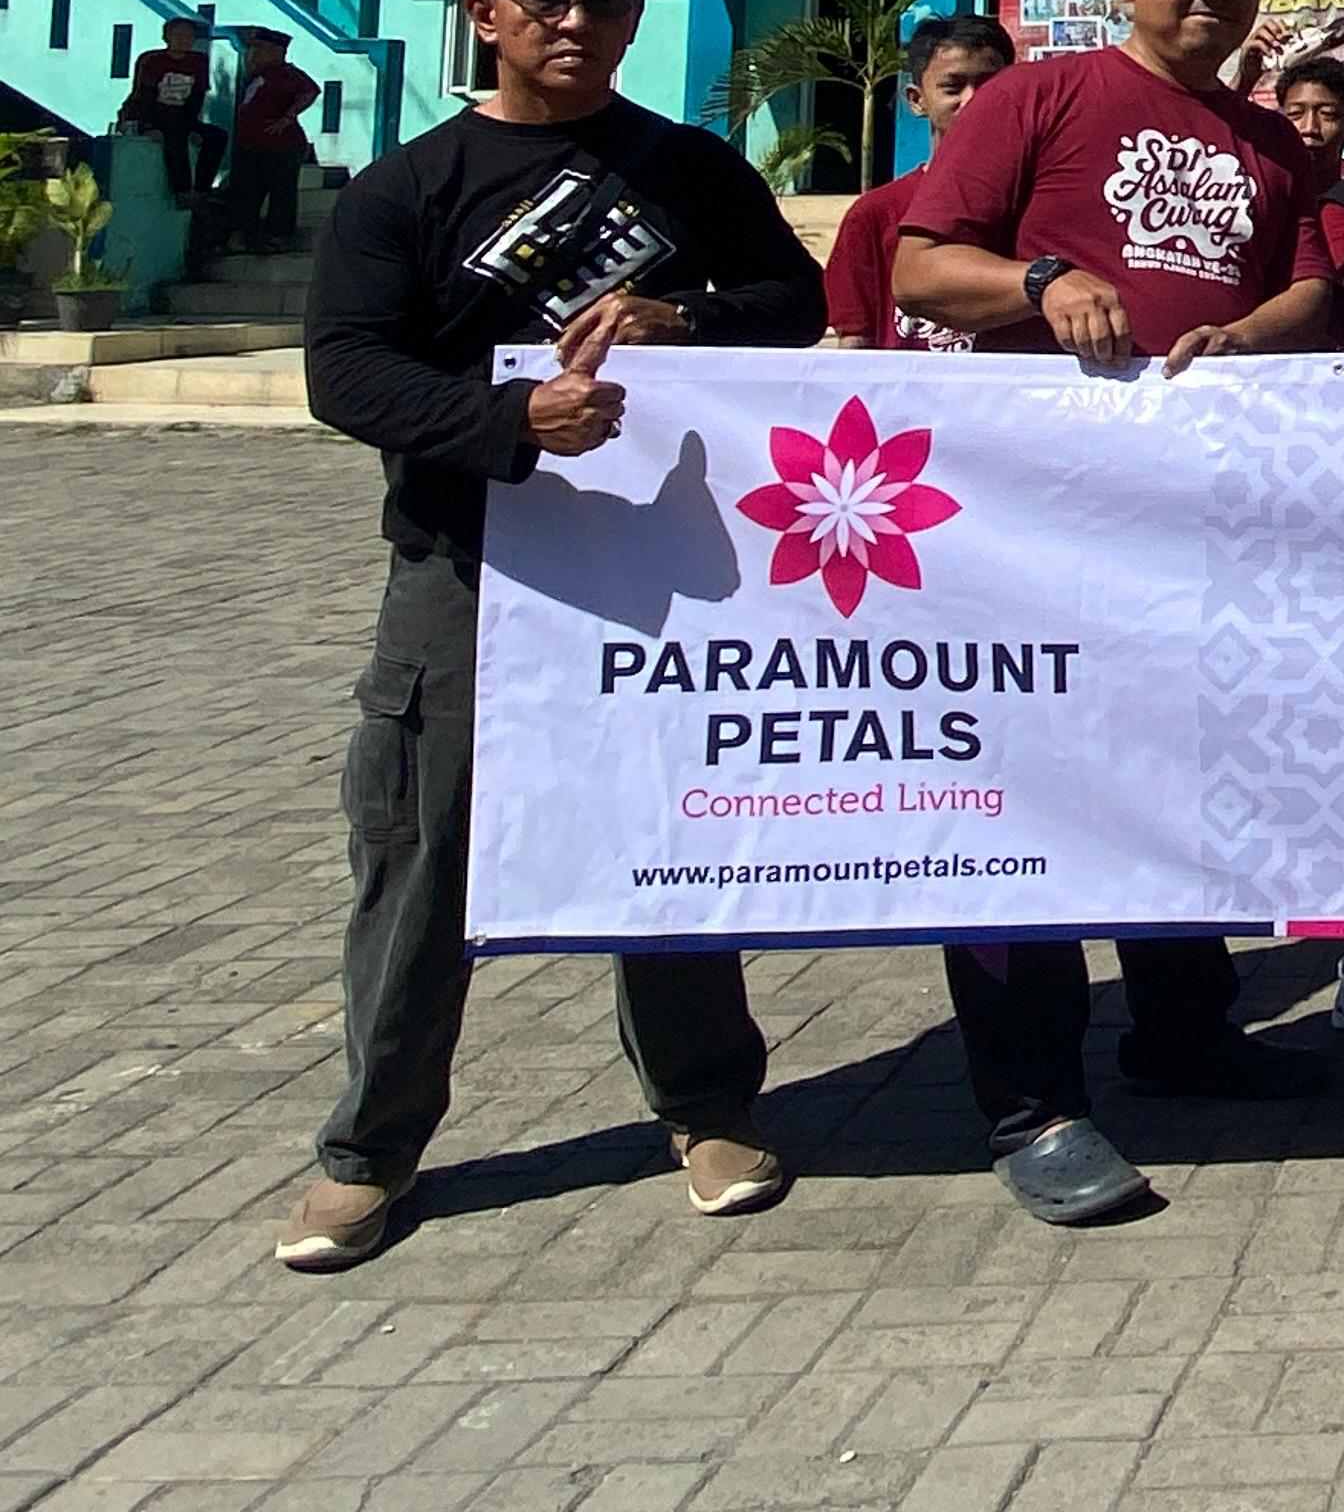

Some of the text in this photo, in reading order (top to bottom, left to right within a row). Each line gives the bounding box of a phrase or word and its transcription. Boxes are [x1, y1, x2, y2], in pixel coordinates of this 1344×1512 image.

[1135, 138, 1202, 174] SDI
[1112, 167, 1250, 203] Assalam
[1139, 196, 1246, 247] Curug
[600, 637, 1080, 695] PARAMOUNT
[705, 709, 982, 766] PETALS
[681, 781, 1004, 819] Connected Living
[631, 853, 1048, 889] www.paramountpetals.com
